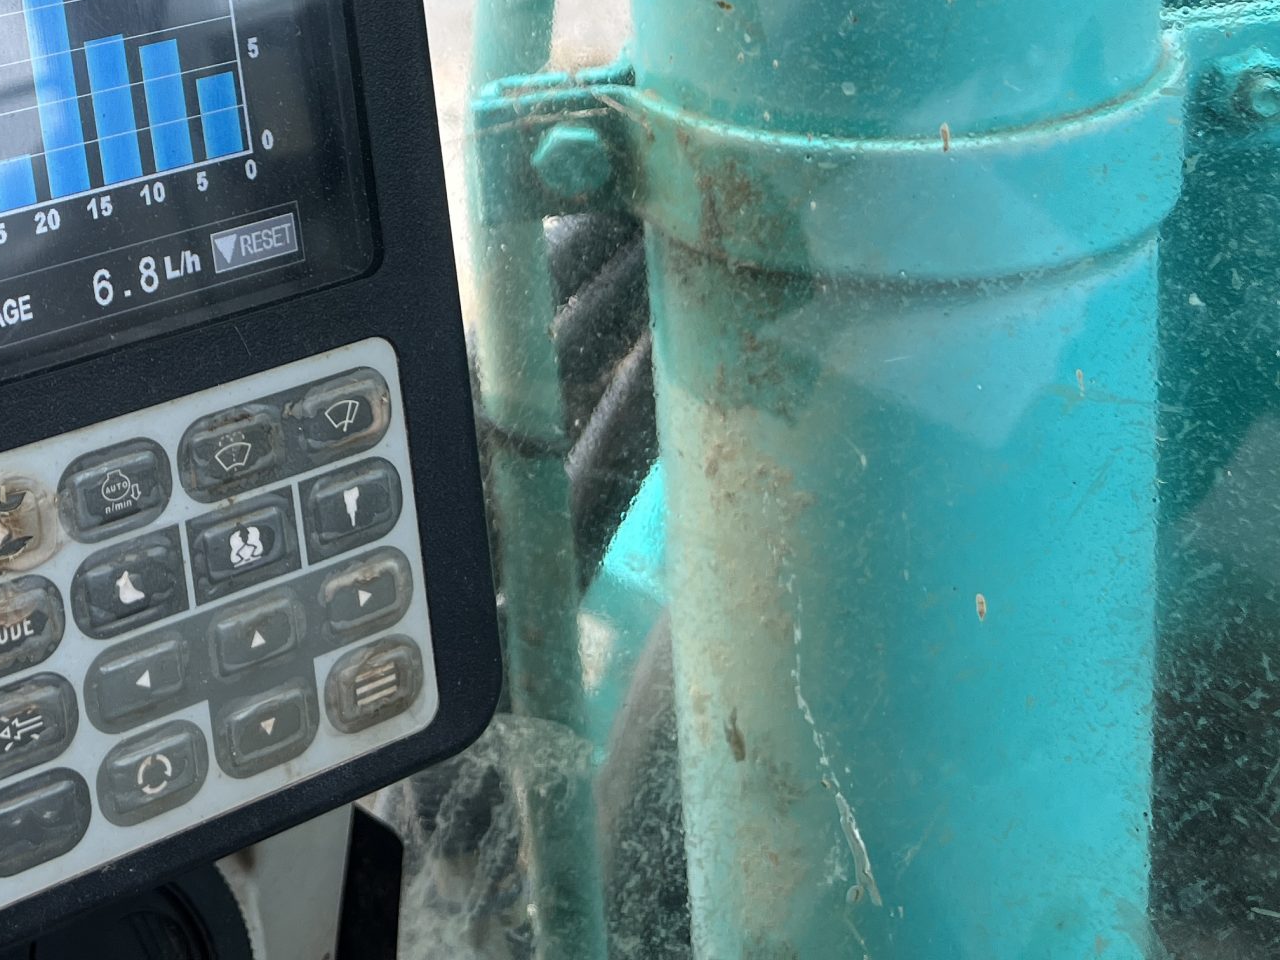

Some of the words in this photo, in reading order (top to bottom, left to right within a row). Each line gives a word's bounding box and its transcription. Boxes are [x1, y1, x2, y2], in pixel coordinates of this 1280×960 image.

[247, 36, 260, 59] 5
[261, 128, 274, 150] 0
[34, 208, 61, 235] 20
[86, 195, 113, 220] 15
[139, 181, 166, 206] 10
[196, 171, 209, 192] 5
[244, 159, 258, 180] 0
[239, 222, 292, 256] RESET
[105, 480, 128, 495] AUTO
[105, 499, 133, 515] n/min
